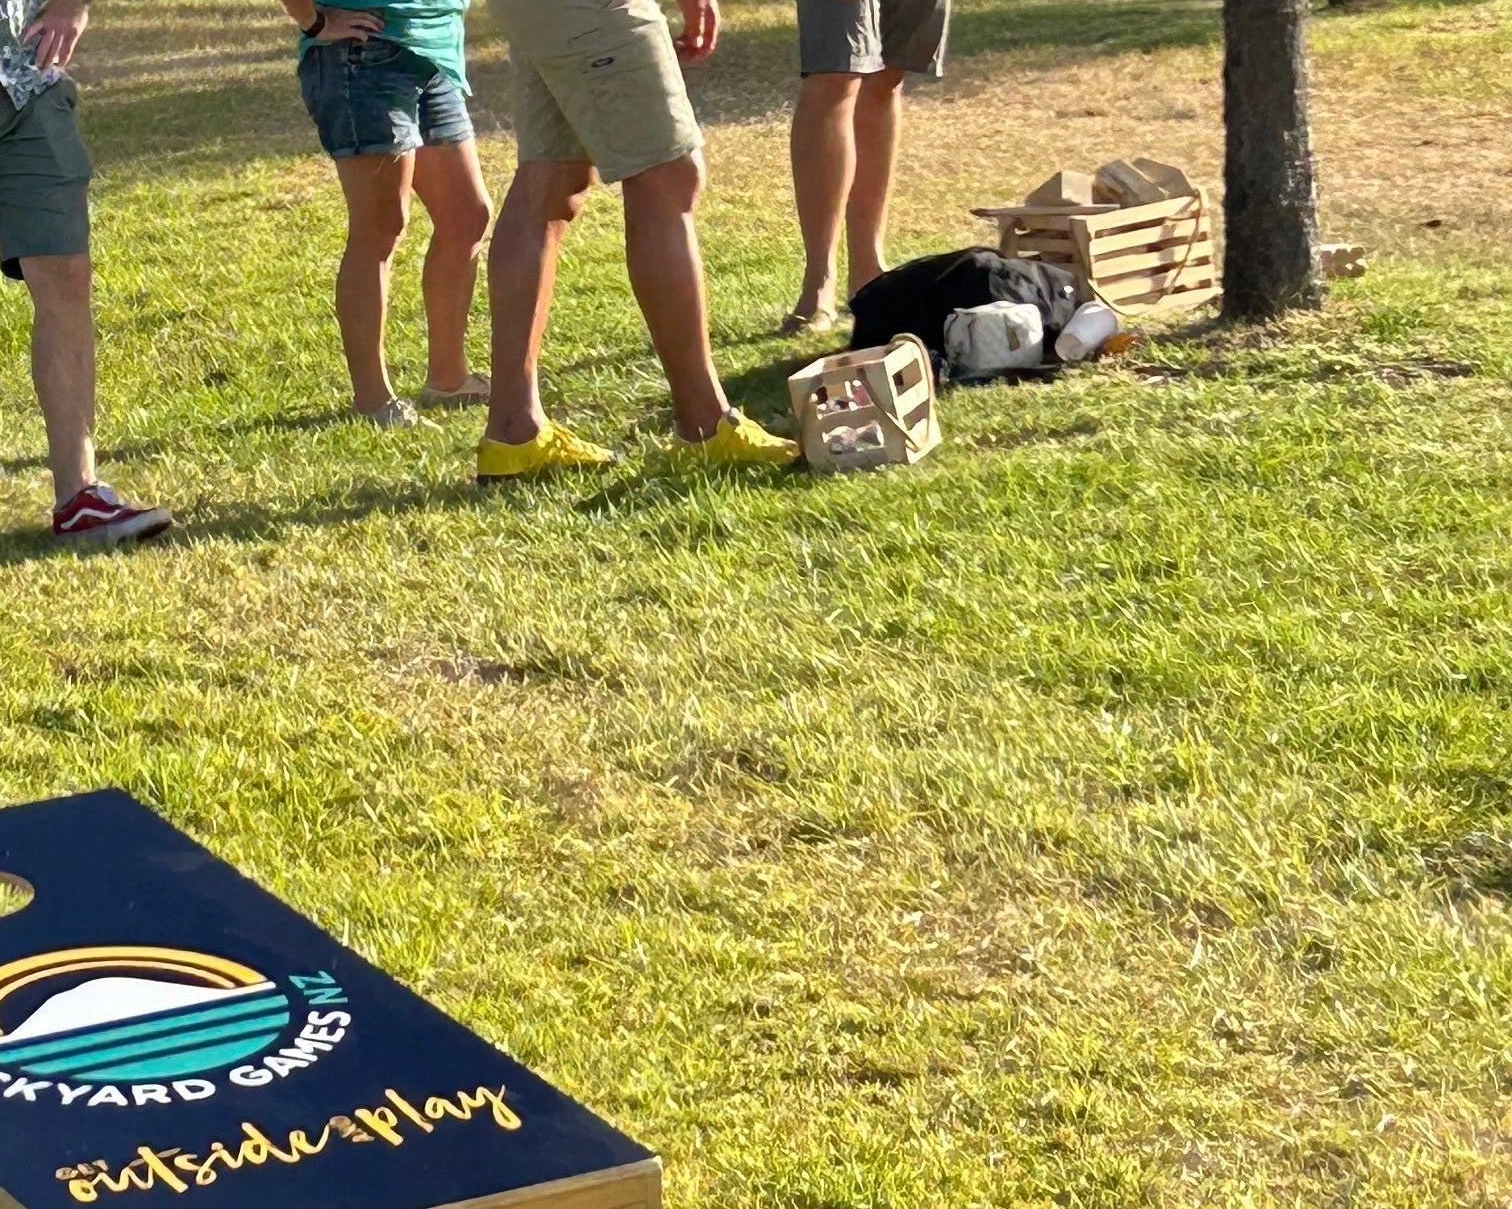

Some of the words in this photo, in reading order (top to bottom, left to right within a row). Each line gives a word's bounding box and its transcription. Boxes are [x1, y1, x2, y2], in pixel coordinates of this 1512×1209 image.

[288, 970, 349, 1005] NZ
[228, 1010, 352, 1087] GAMES
[68, 1122, 330, 1202] outside
[354, 1084, 523, 1147] play
